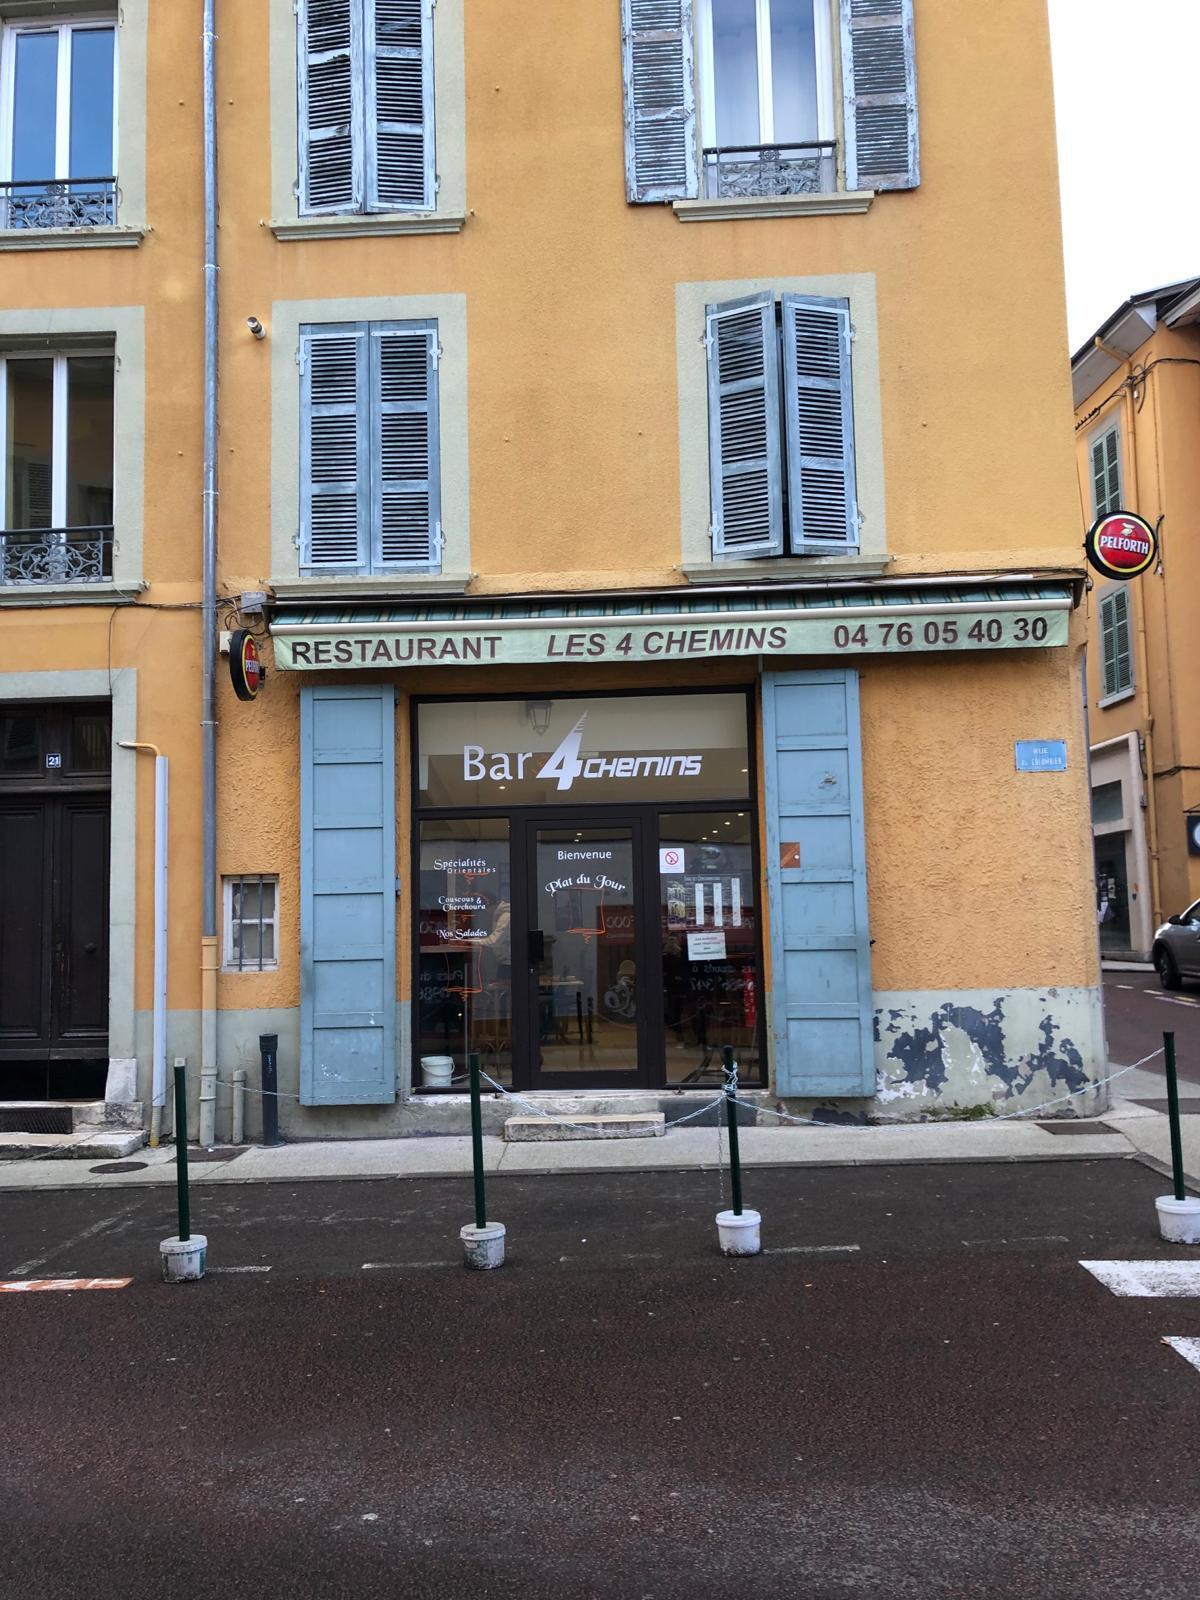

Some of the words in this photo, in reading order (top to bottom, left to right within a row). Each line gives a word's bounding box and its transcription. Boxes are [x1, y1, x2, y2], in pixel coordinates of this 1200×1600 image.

[1100, 535, 1149, 554] PELFORTH
[291, 636, 502, 664] RESTAURANT
[547, 633, 607, 657] LES
[615, 632, 633, 656] 4
[643, 627, 788, 655] CHEMINS
[833, 624, 868, 648] 04
[878, 622, 914, 647] 76
[924, 621, 959, 645] 05
[967, 618, 1002, 643] 40
[1013, 616, 1048, 641] 30
[48, 756, 59, 766] 21
[463, 745, 533, 781] Bar
[557, 850, 612, 860] Bienvenue
[433, 858, 486, 871] Spécialités
[447, 866, 496, 874] Orientales
[544, 877, 573, 897] Plat
[576, 873, 591, 884] du
[593, 874, 626, 891] Jour
[438, 896, 474, 904] Couscous
[436, 929, 454, 940] Nos
[455, 929, 488, 940] Salades
